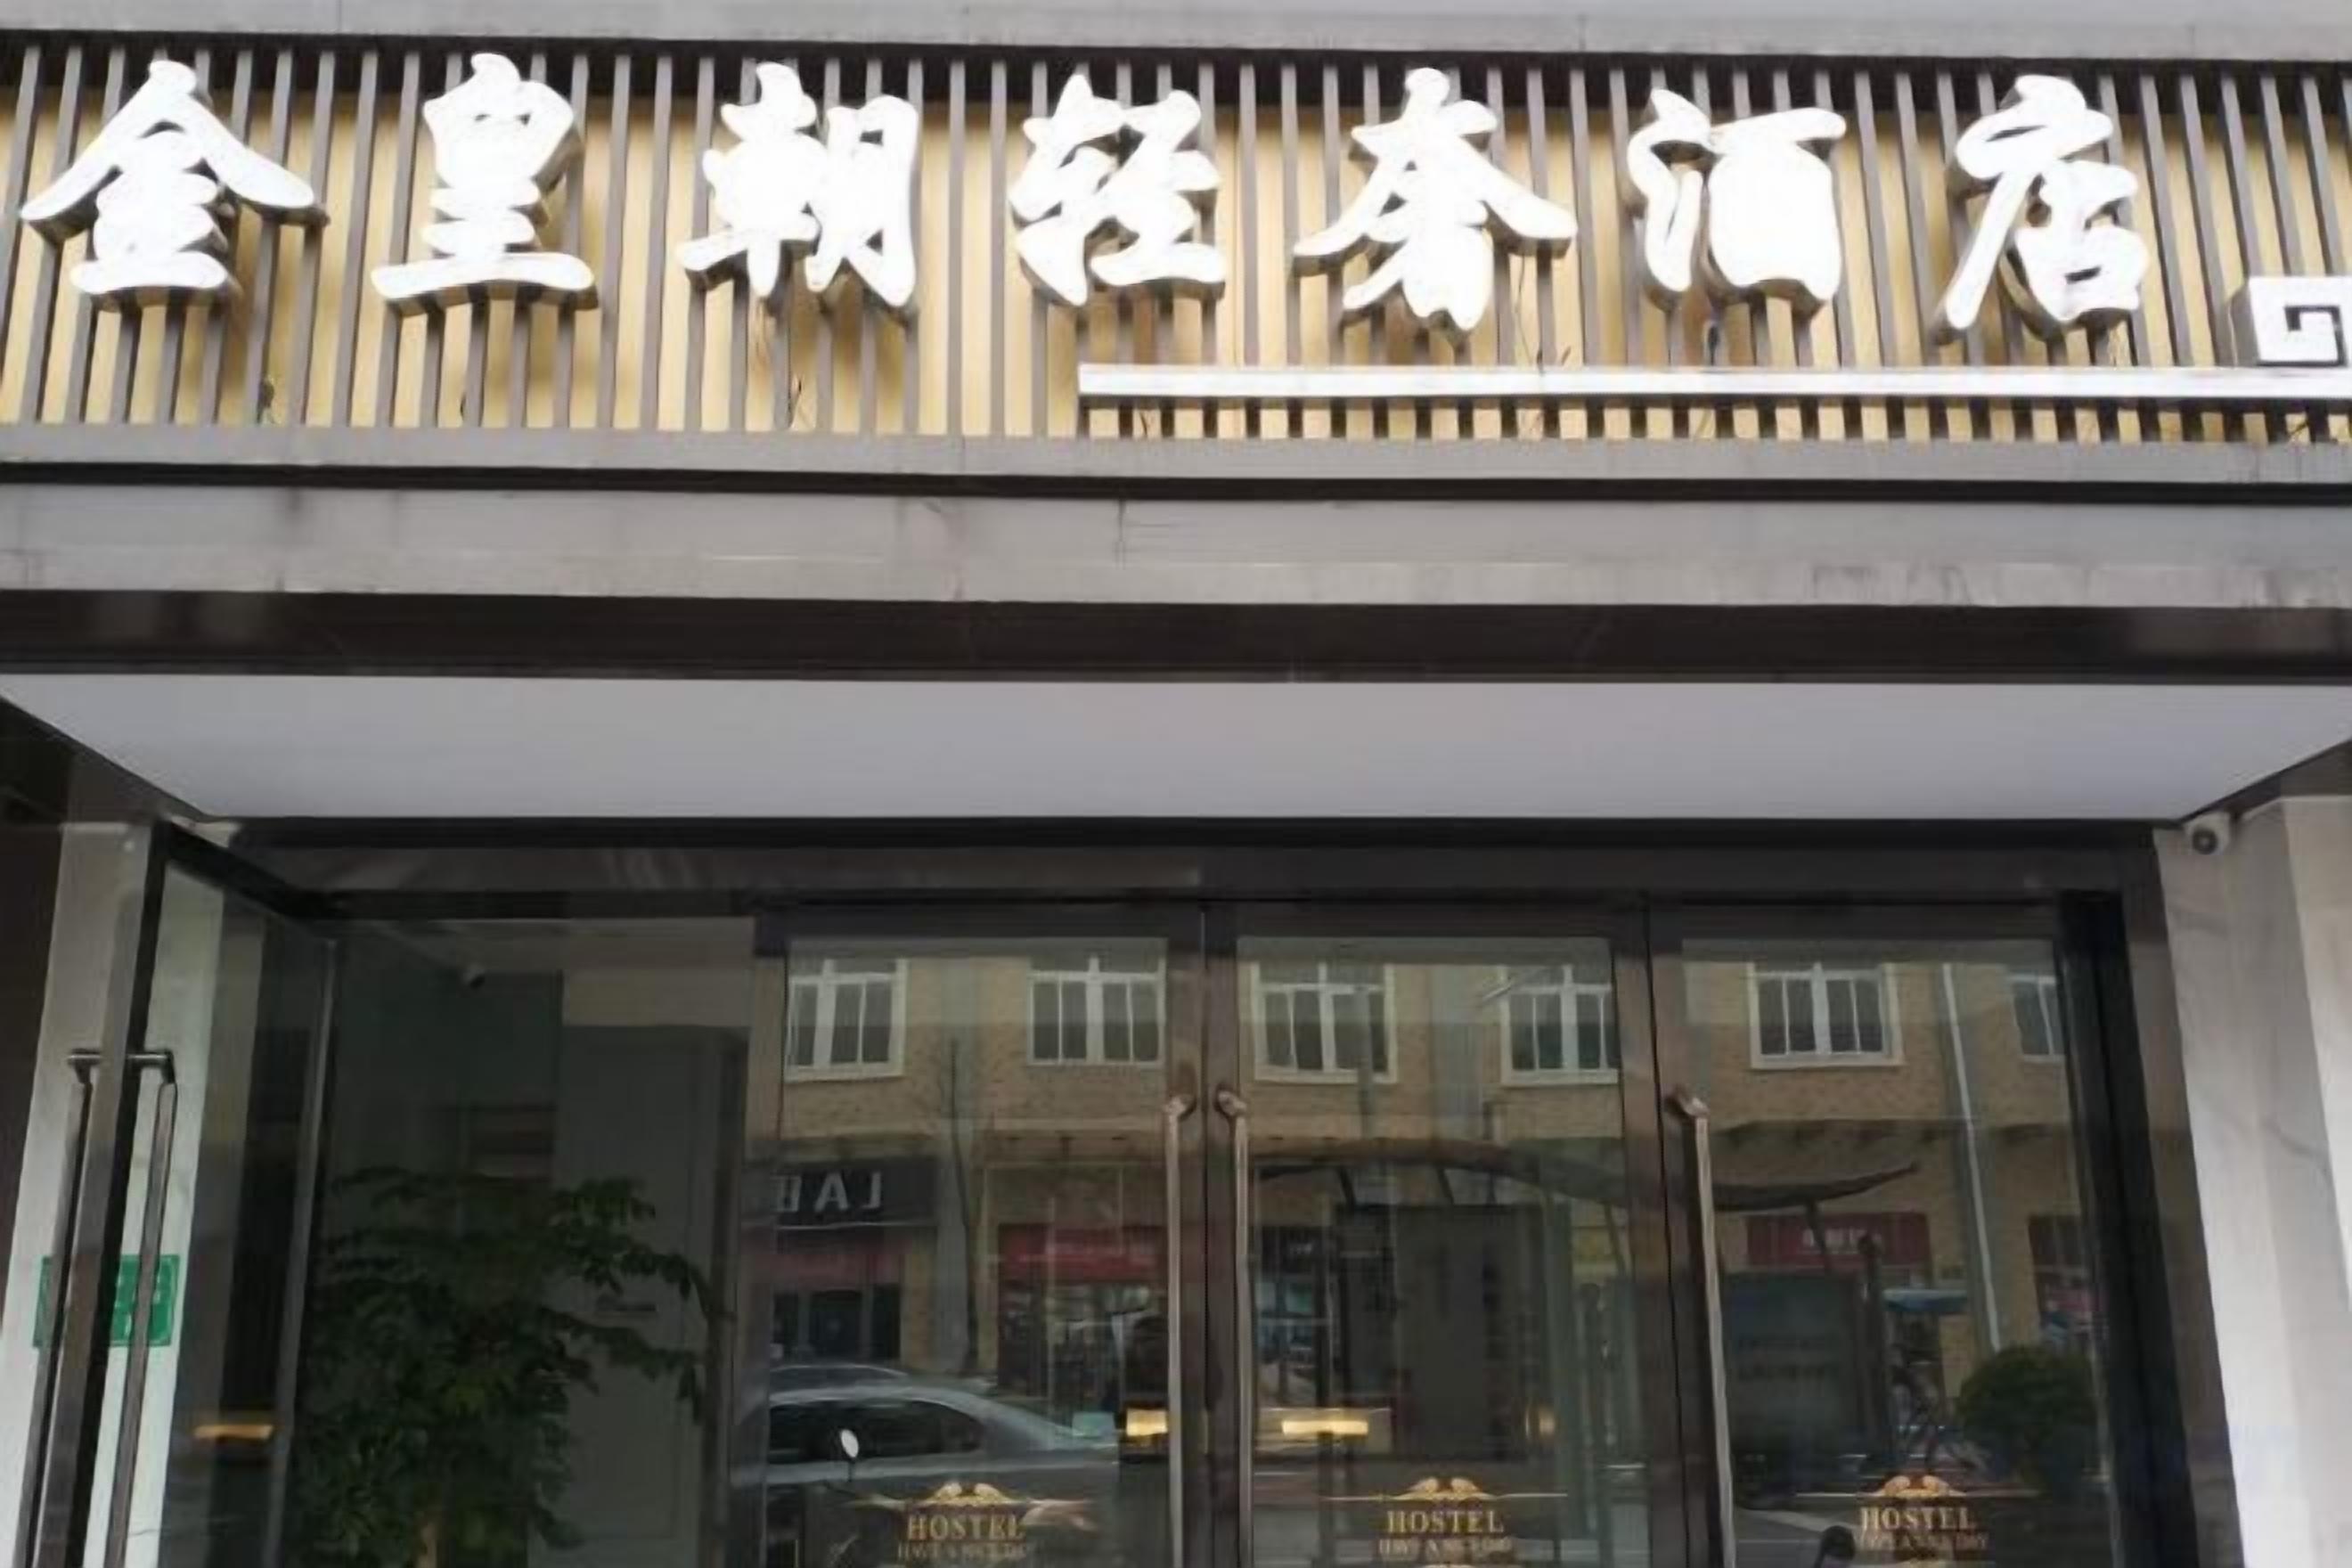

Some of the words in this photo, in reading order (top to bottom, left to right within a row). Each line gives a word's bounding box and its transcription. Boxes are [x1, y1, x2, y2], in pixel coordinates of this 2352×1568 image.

[20, 53, 2149, 331] 金皇朝轻奢酒店
[907, 1514, 1025, 1540] HOSTEL
[1386, 1509, 1505, 1533] HOSTEL
[1859, 1506, 1976, 1530] HOSTEL
